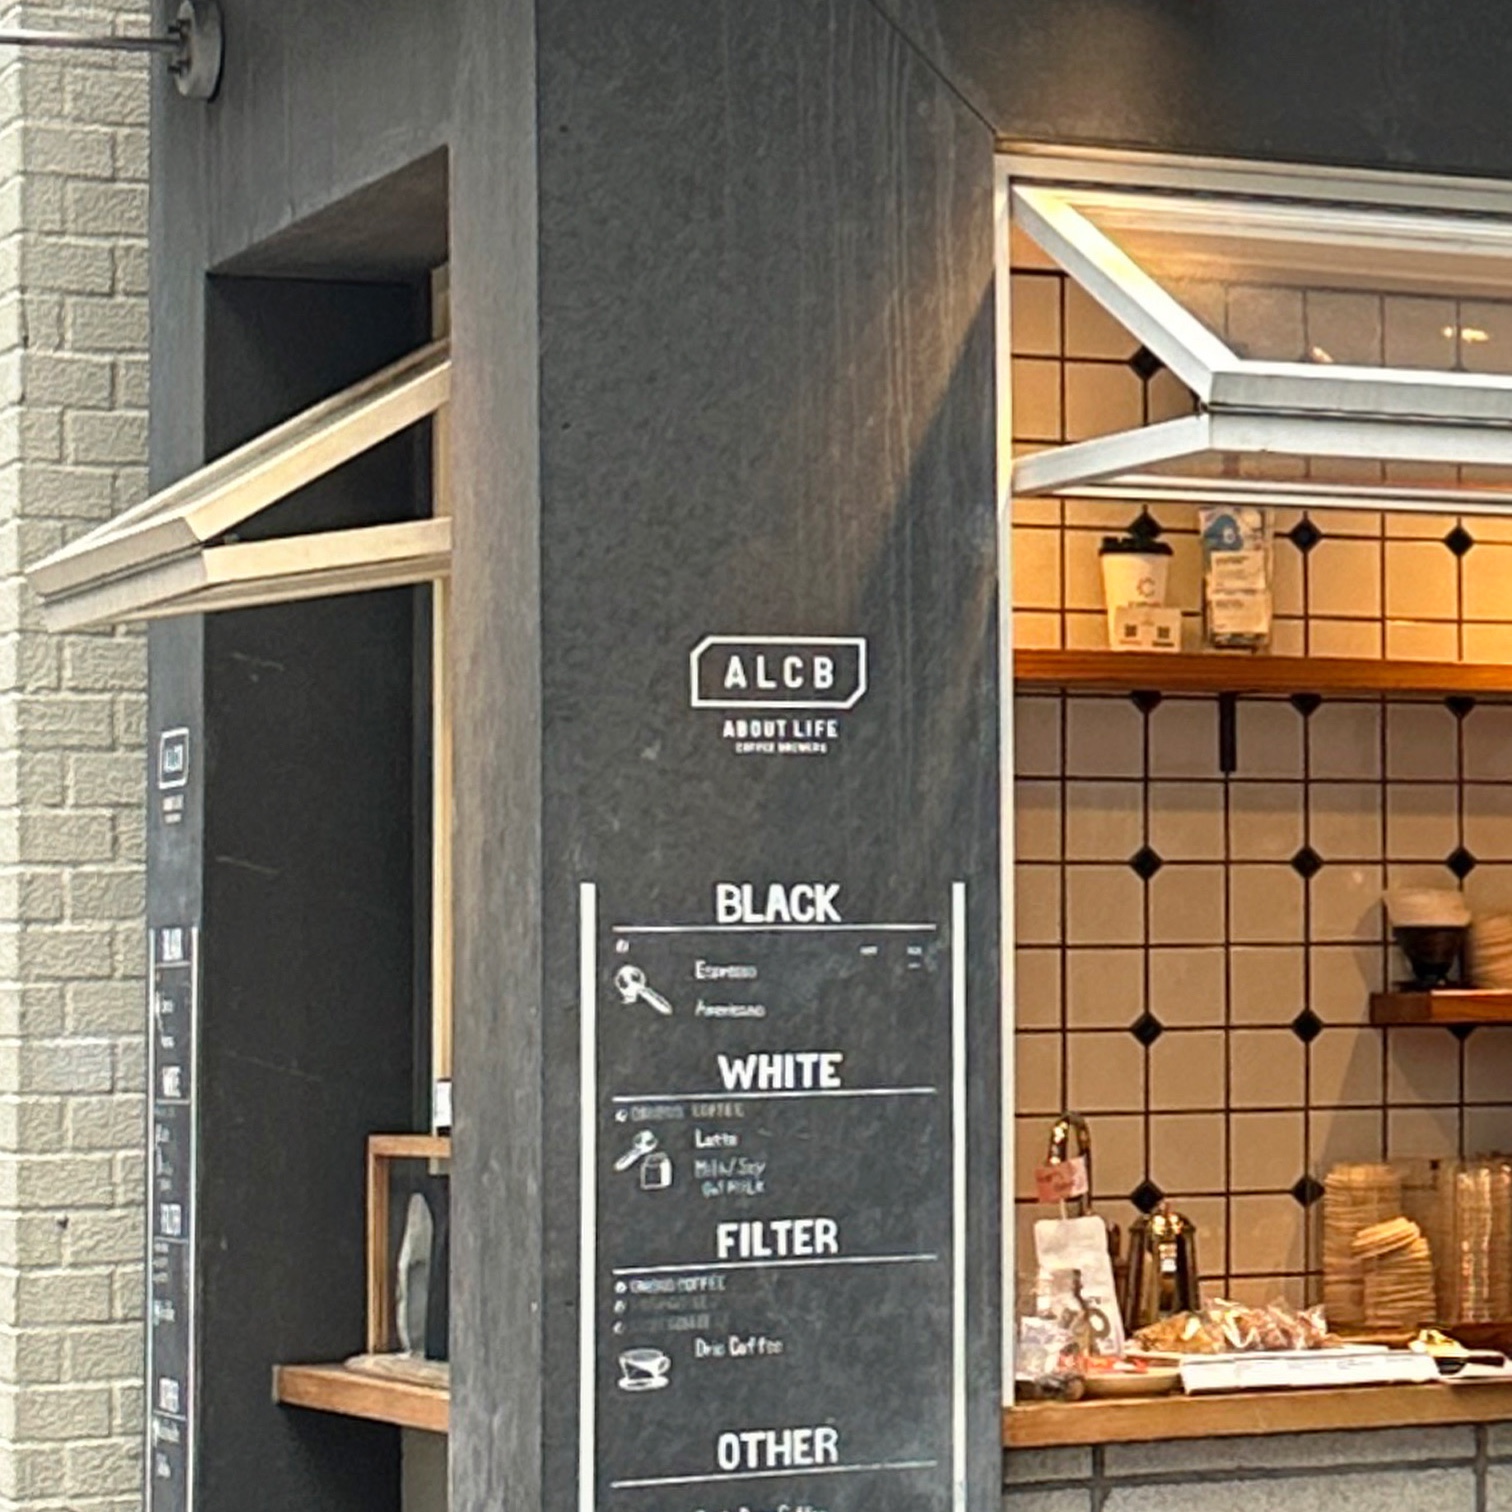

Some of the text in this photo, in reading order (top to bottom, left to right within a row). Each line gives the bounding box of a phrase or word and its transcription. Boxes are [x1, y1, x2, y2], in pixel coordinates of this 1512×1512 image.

[724, 655, 835, 689] ALCB
[723, 719, 838, 738] ABOUT LIFE
[716, 883, 842, 923] BLACK
[717, 1052, 844, 1091] WHITE
[716, 1219, 839, 1259] FILTER
[717, 1426, 839, 1470] OTHER
